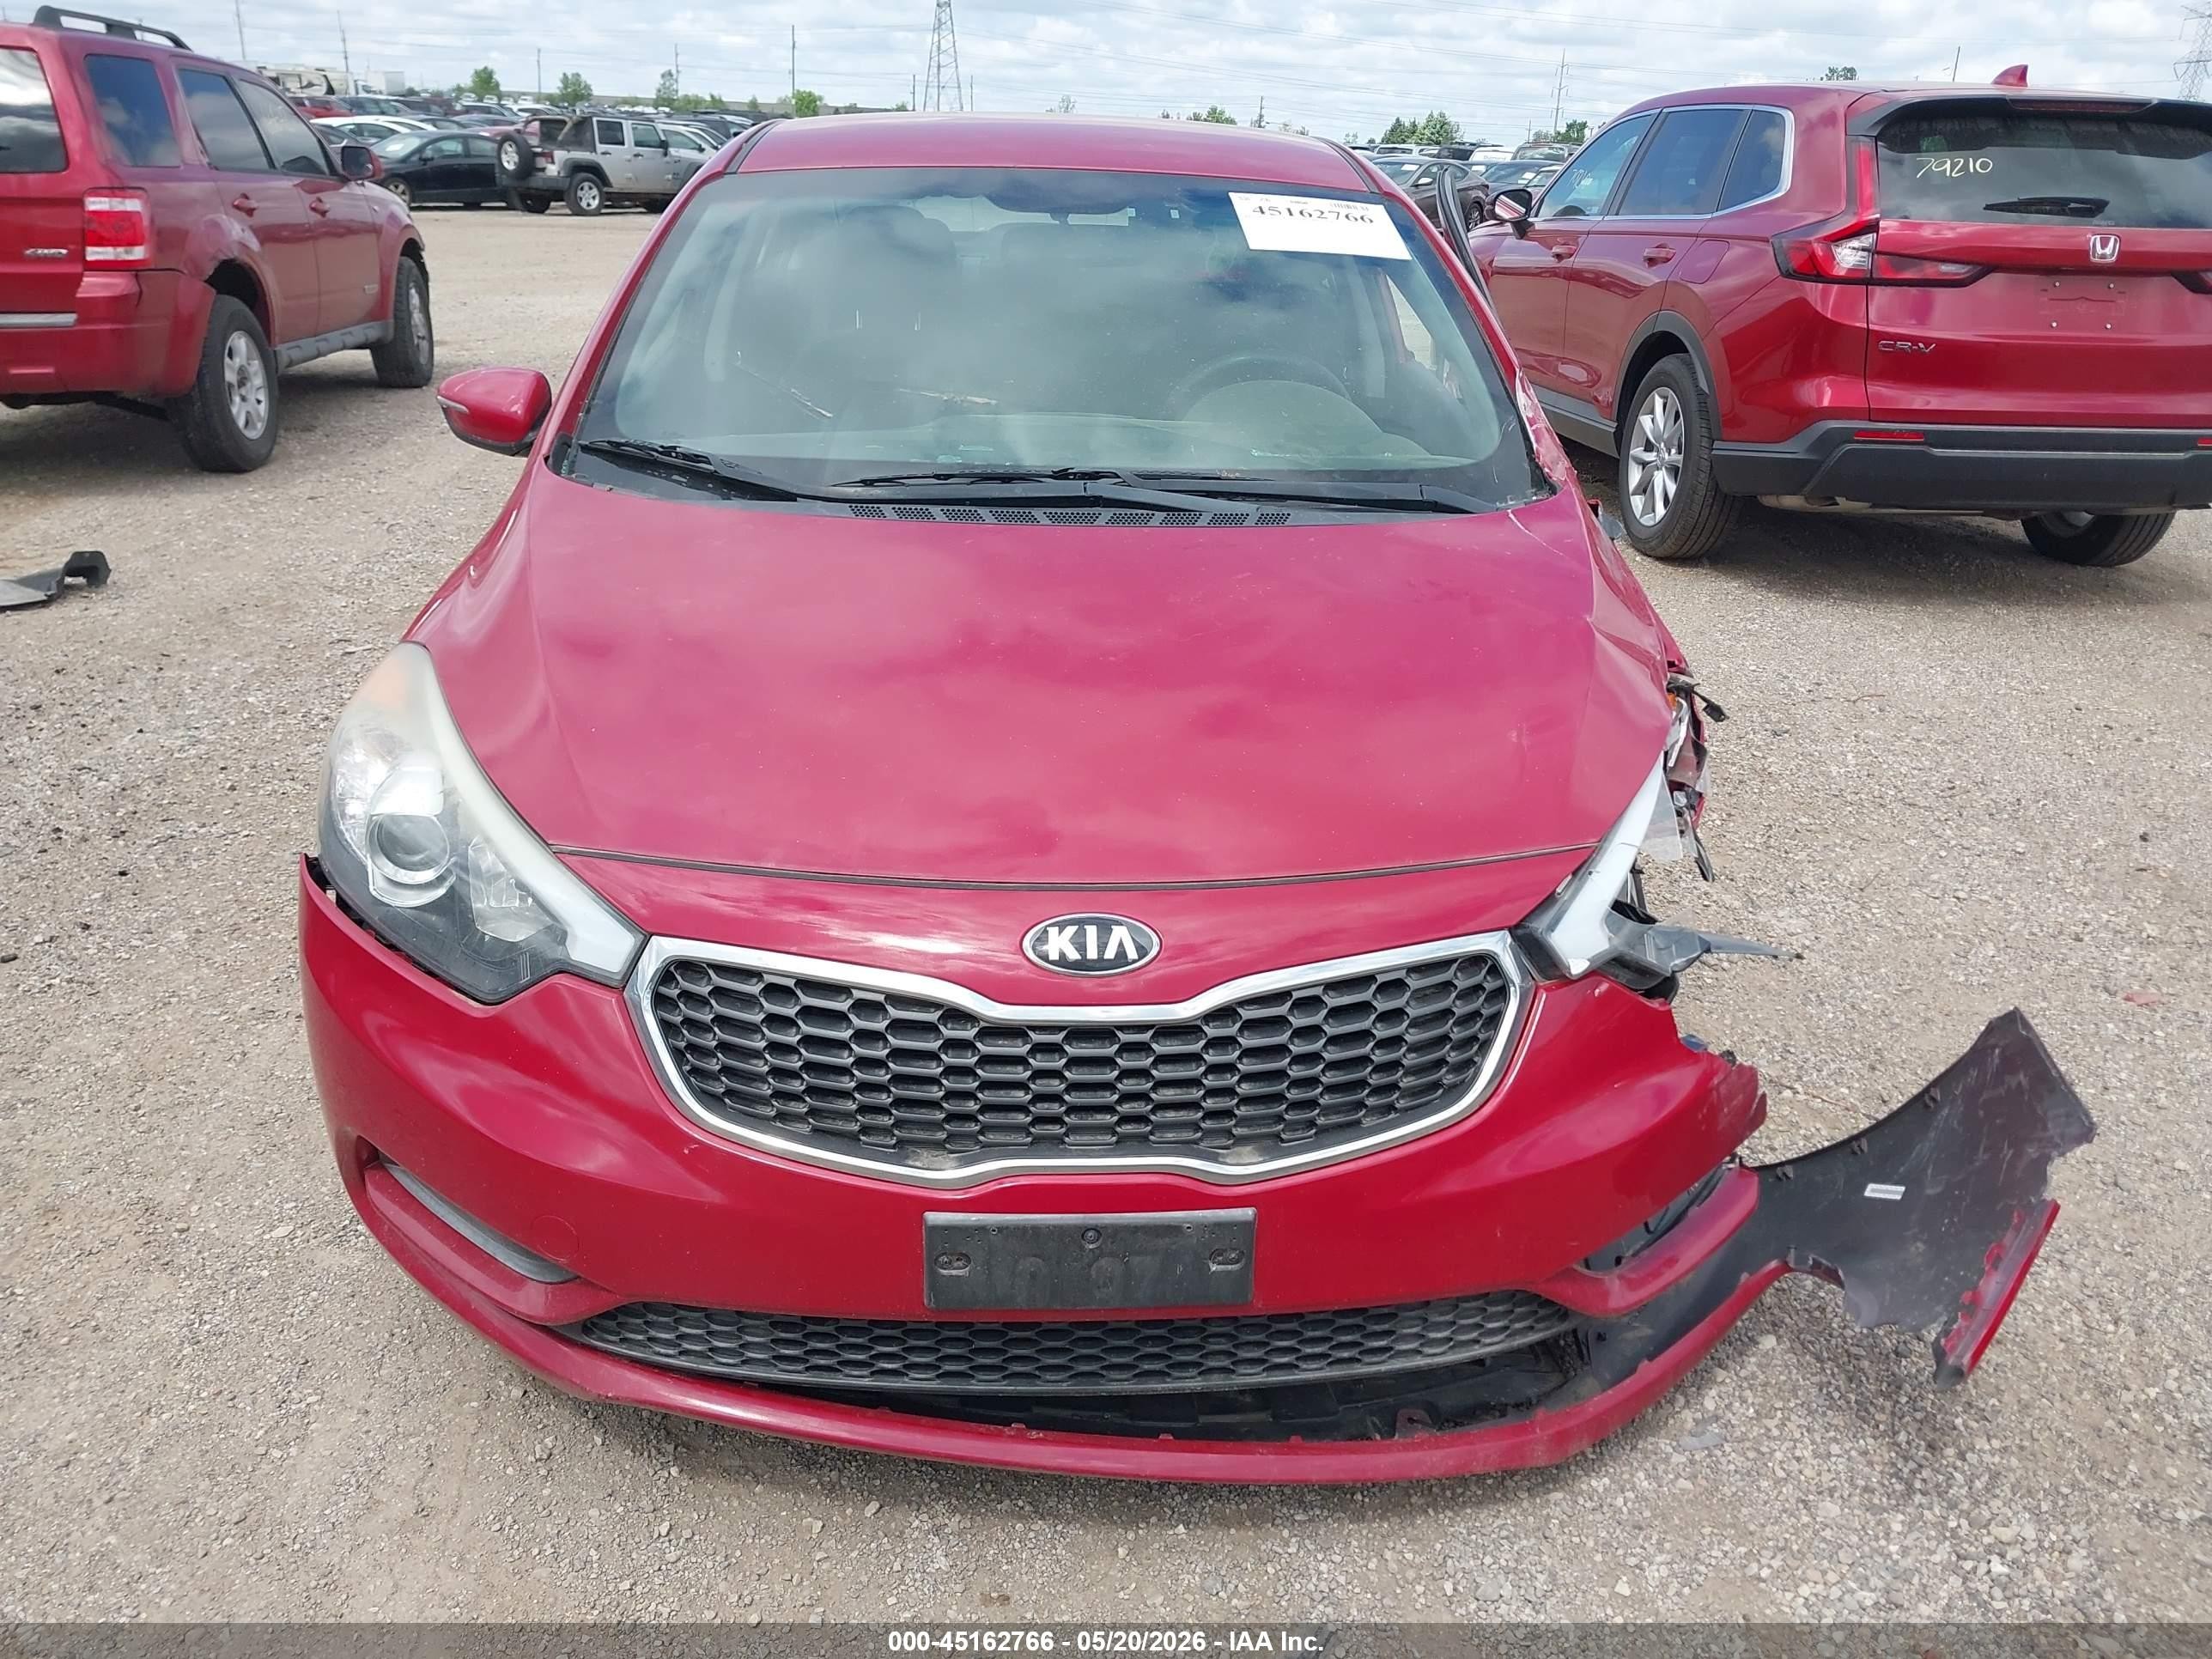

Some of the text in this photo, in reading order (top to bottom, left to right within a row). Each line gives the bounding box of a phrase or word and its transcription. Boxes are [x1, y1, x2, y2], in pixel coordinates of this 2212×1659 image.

[1916, 157, 1993, 179] 79210
[1252, 205, 1374, 224] 45162766
[1878, 340, 1936, 353] CR-V
[1046, 925, 1139, 961] KIA
